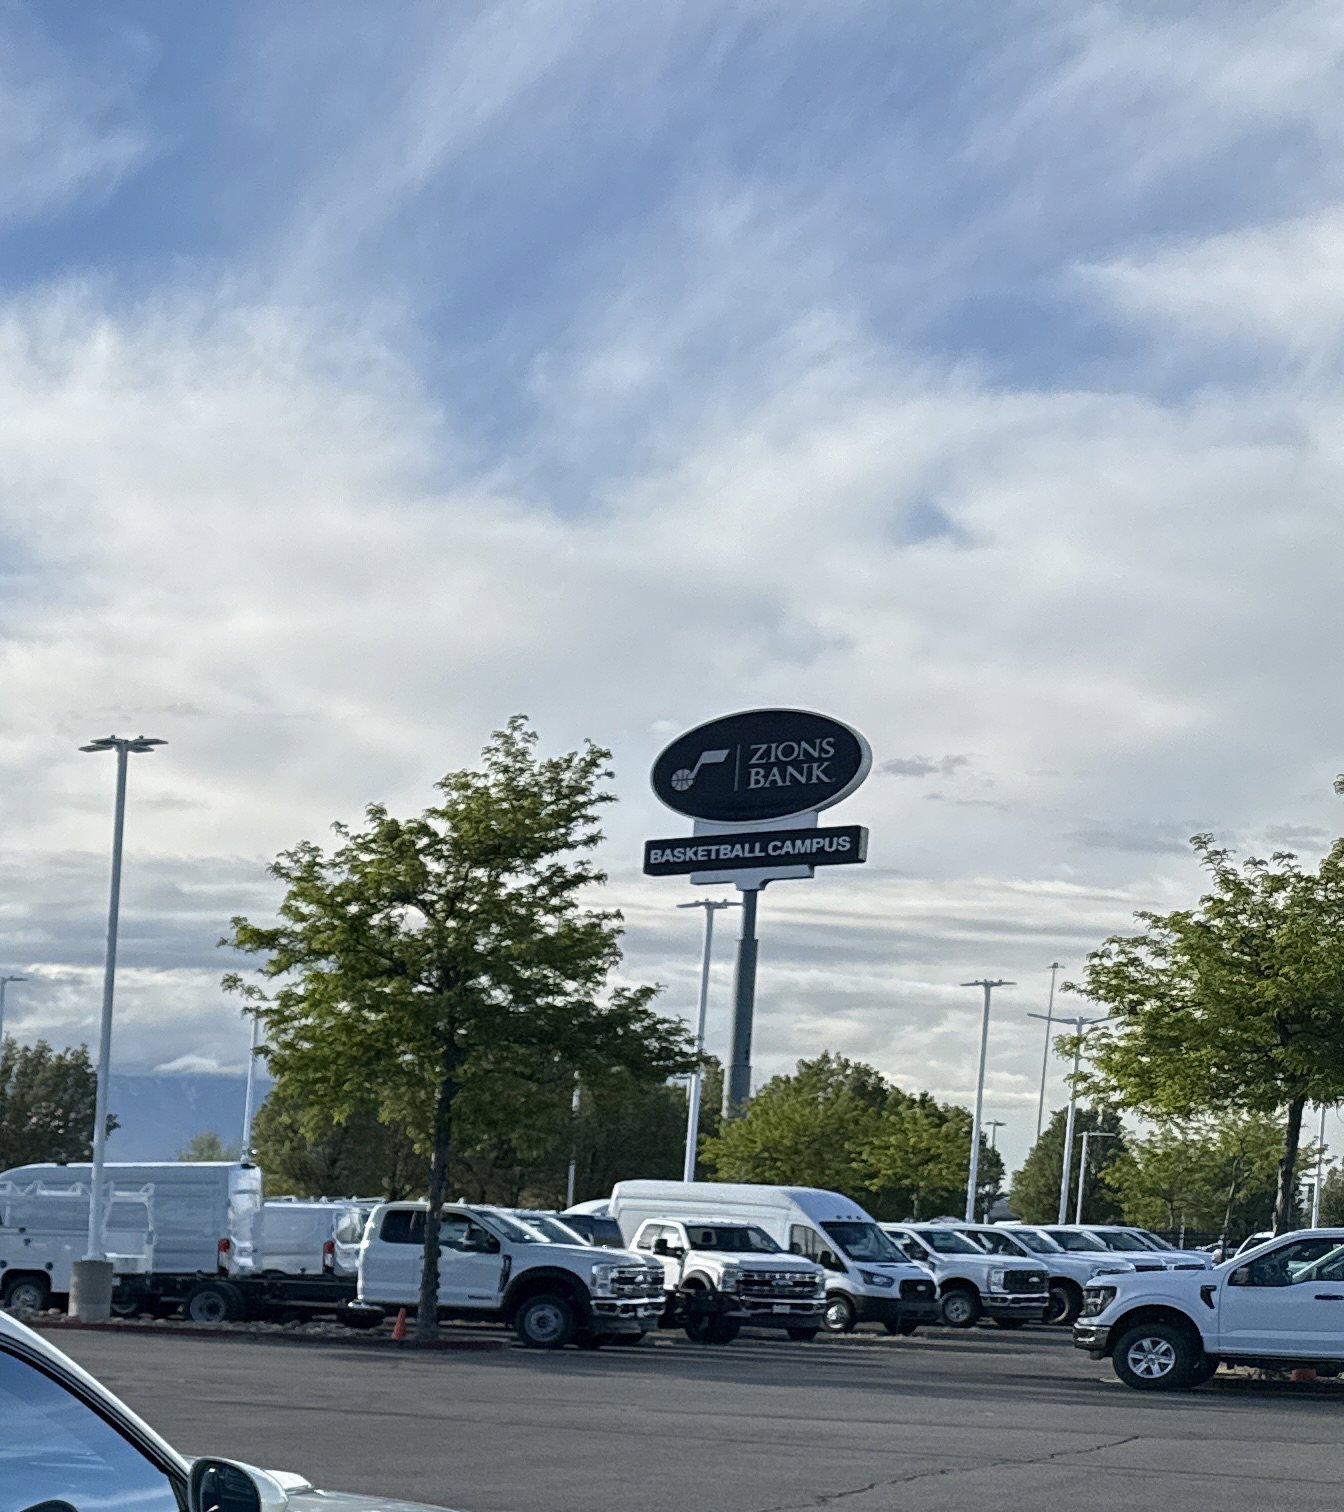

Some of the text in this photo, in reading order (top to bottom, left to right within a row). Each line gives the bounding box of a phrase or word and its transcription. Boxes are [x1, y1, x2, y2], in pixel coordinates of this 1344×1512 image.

[749, 737, 835, 765] ZIONS
[746, 761, 833, 790] BANK
[649, 836, 852, 865] BASKETBALL CAMPUS
